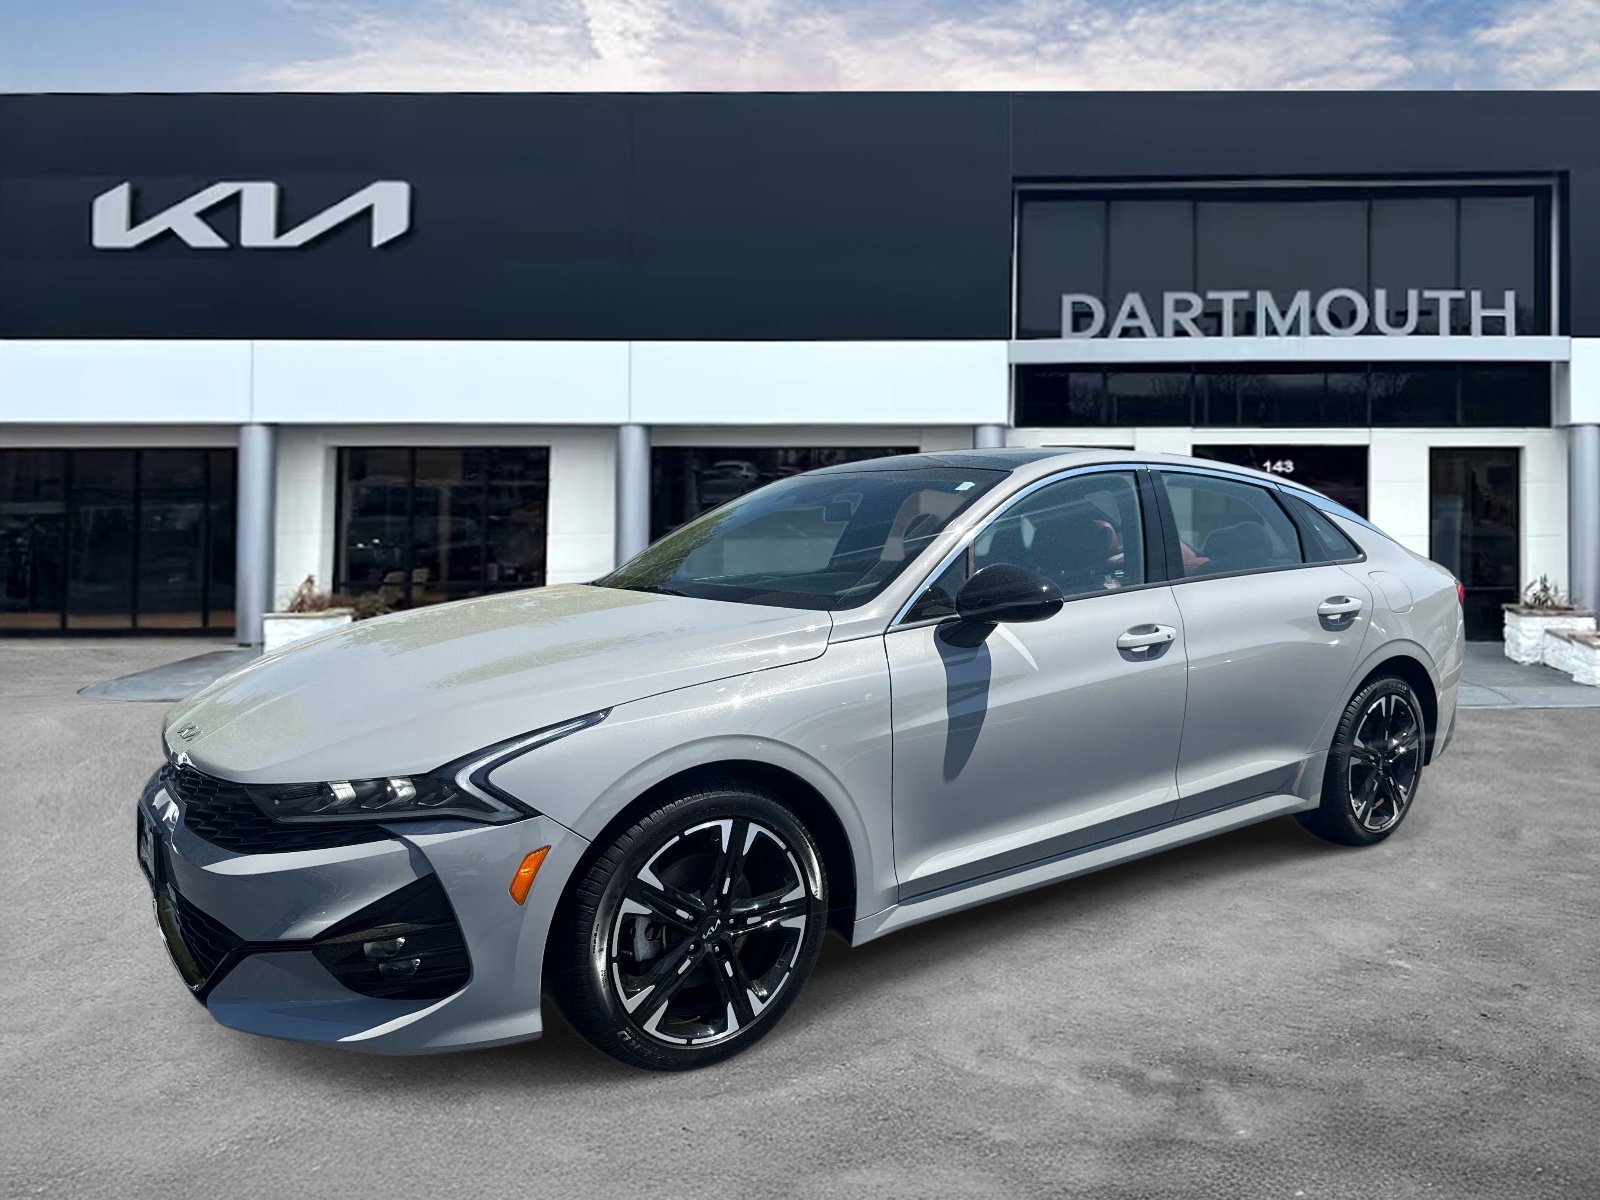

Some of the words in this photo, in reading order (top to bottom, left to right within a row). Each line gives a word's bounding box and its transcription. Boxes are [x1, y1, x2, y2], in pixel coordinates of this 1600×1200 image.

[92, 180, 411, 250] KIA
[1061, 288, 1516, 337] DARTMOUTH
[1262, 459, 1295, 473] 143
